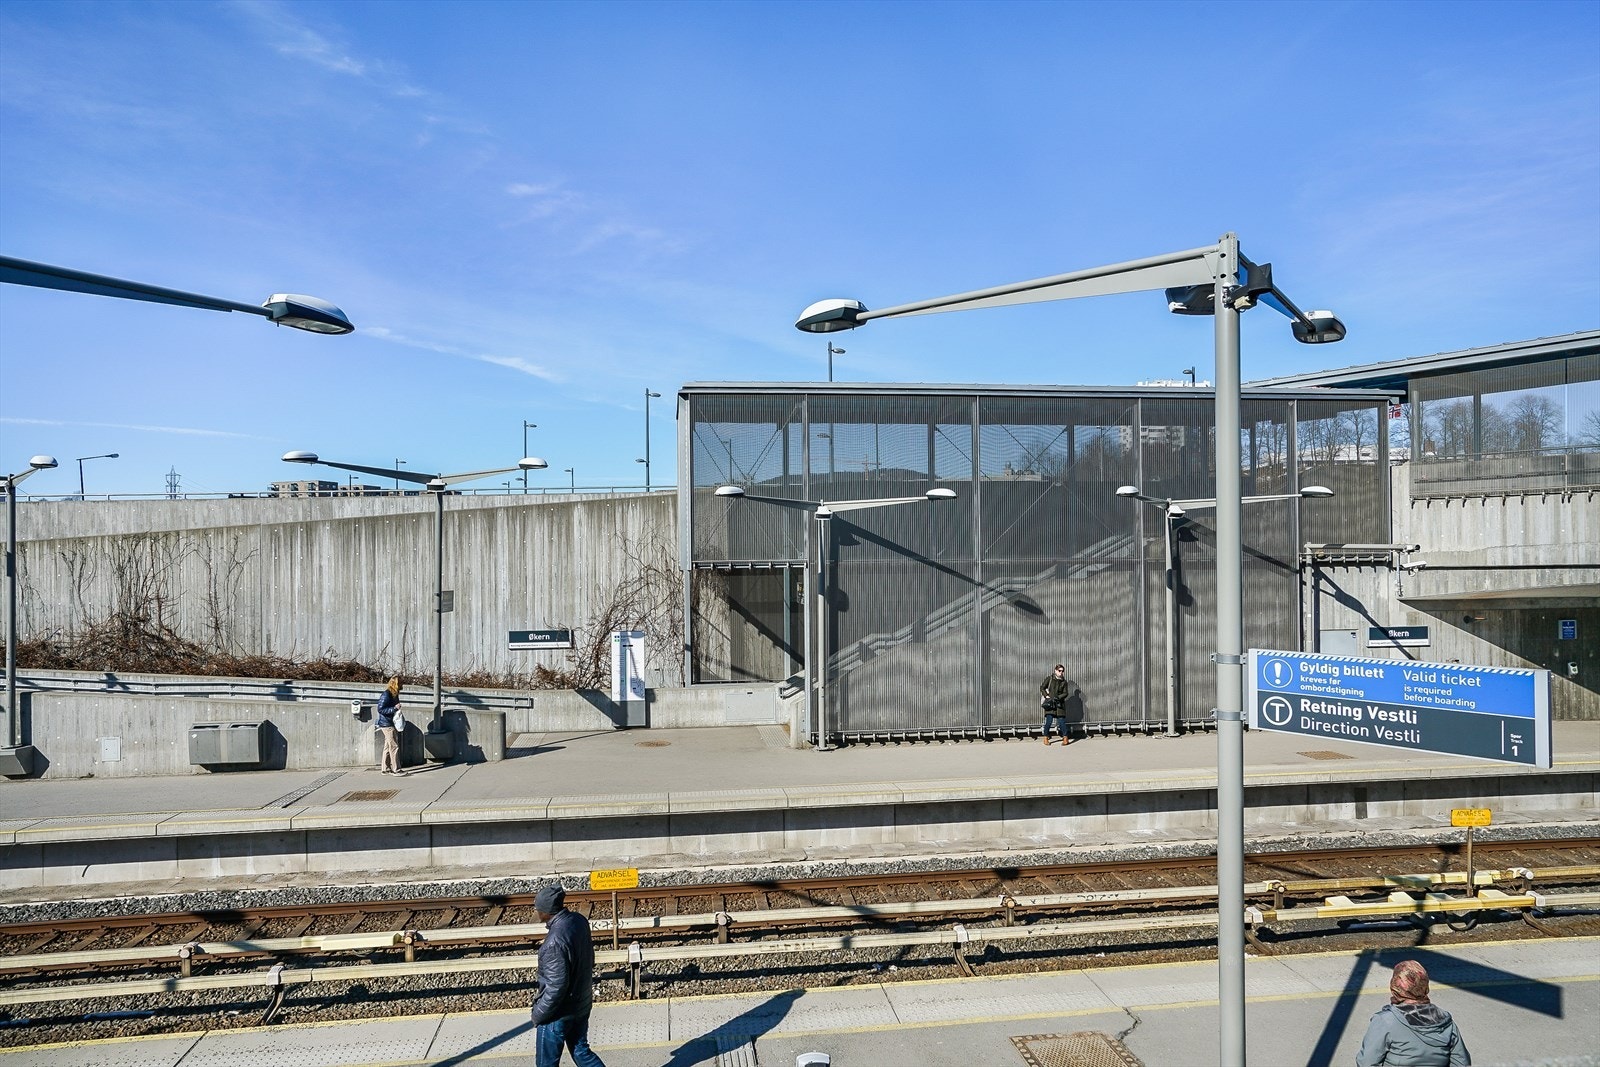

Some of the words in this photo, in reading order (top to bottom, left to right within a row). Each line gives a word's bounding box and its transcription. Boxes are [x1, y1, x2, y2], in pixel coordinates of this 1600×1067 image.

[528, 633, 551, 641] Økern
[1388, 629, 1410, 638] Økern
[1300, 661, 1340, 677] Gyldig
[1343, 665, 1384, 679] billett
[1300, 675, 1328, 684] kreves
[1329, 677, 1342, 686] før
[1403, 669, 1437, 683] Valid
[1441, 673, 1482, 687] ticket
[1300, 684, 1365, 698] ombordstigning
[1404, 684, 1412, 692] is
[1413, 686, 1452, 696] required
[1404, 693, 1433, 703] before
[1434, 696, 1476, 709] boarding
[1300, 698, 1363, 721] Retning
[1367, 705, 1417, 725] Vestli
[1301, 716, 1370, 737] Direction
[1374, 725, 1421, 744] Vestli
[1511, 745, 1518, 757] 1
[596, 870, 632, 879] ADVARSEL
